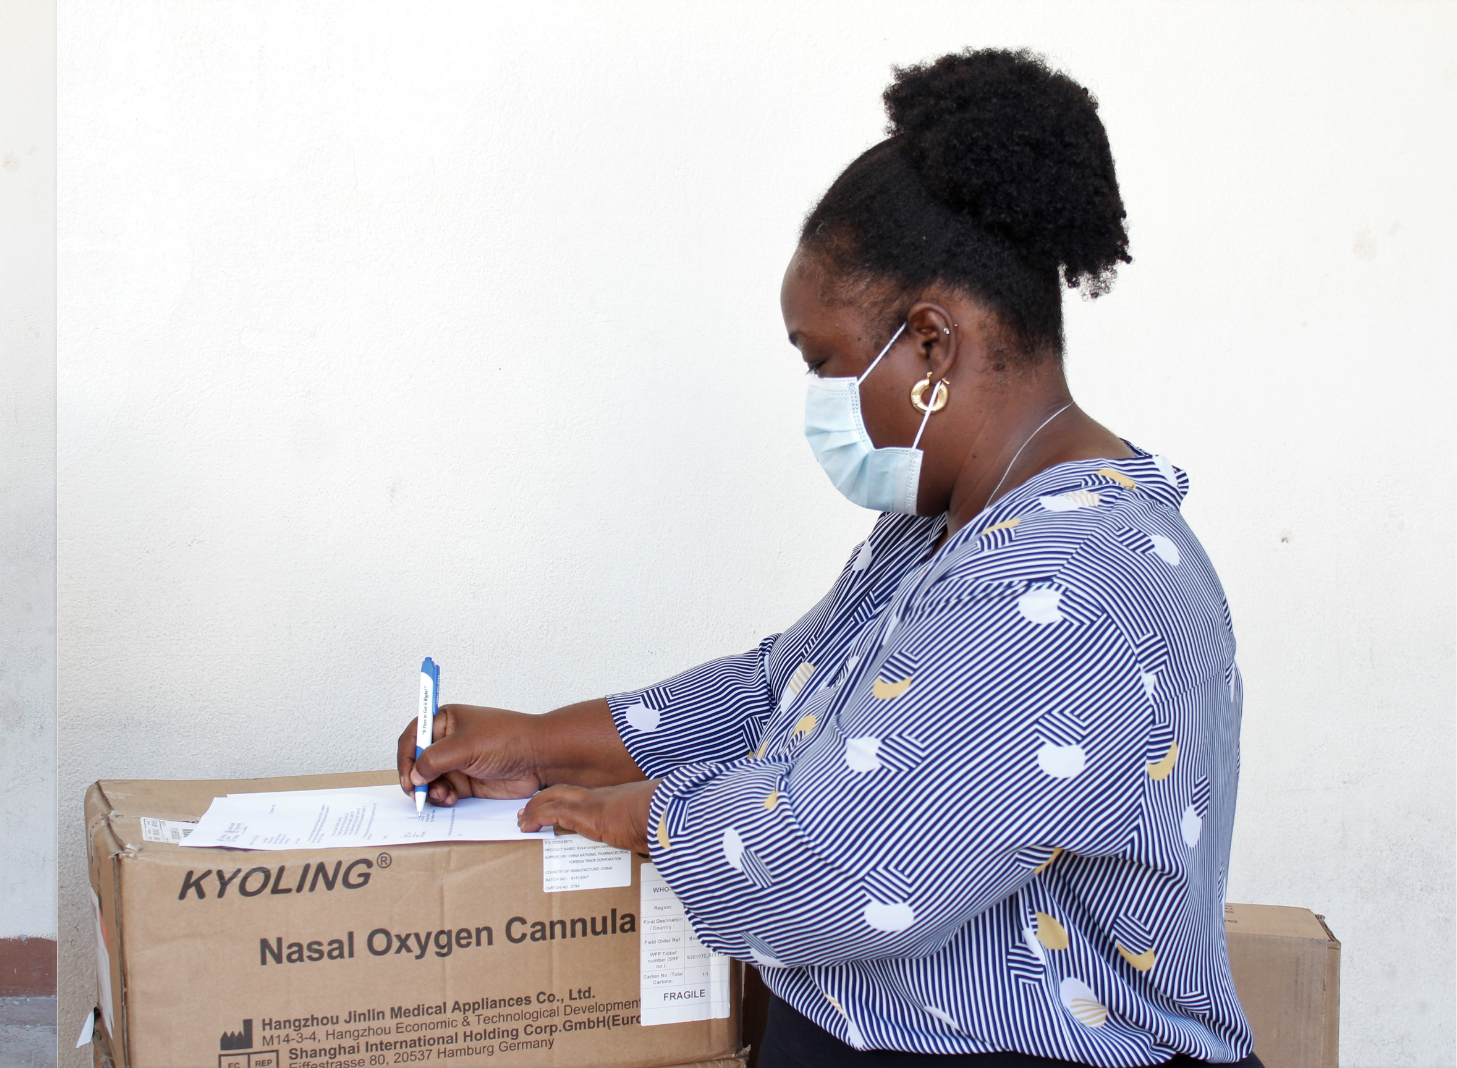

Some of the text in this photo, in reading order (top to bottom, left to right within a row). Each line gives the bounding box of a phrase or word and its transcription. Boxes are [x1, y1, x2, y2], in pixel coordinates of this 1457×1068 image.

[260, 908, 636, 966] Nasal Oxygen Cannula
[262, 987, 596, 1032] Hangzhou Jinlin Medical Appliances Co., Ltd.
[663, 989, 706, 1001] FRAGILE
[262, 1030, 321, 1046] M14-3-4,
[326, 1020, 391, 1041] Hangzhou
[396, 1016, 458, 1034] Economic
[462, 1015, 471, 1027] &
[475, 1004, 560, 1025] Technological
[288, 1042, 360, 1061] Shanghai
[365, 1032, 458, 1053] International
[463, 1027, 519, 1043] Holding
[370, 1054, 389, 1067] 80,
[394, 1049, 432, 1064] 20537
[437, 1042, 494, 1060] Hamburg
[498, 1037, 555, 1052] Germany
[255, 1059, 273, 1067] REP
